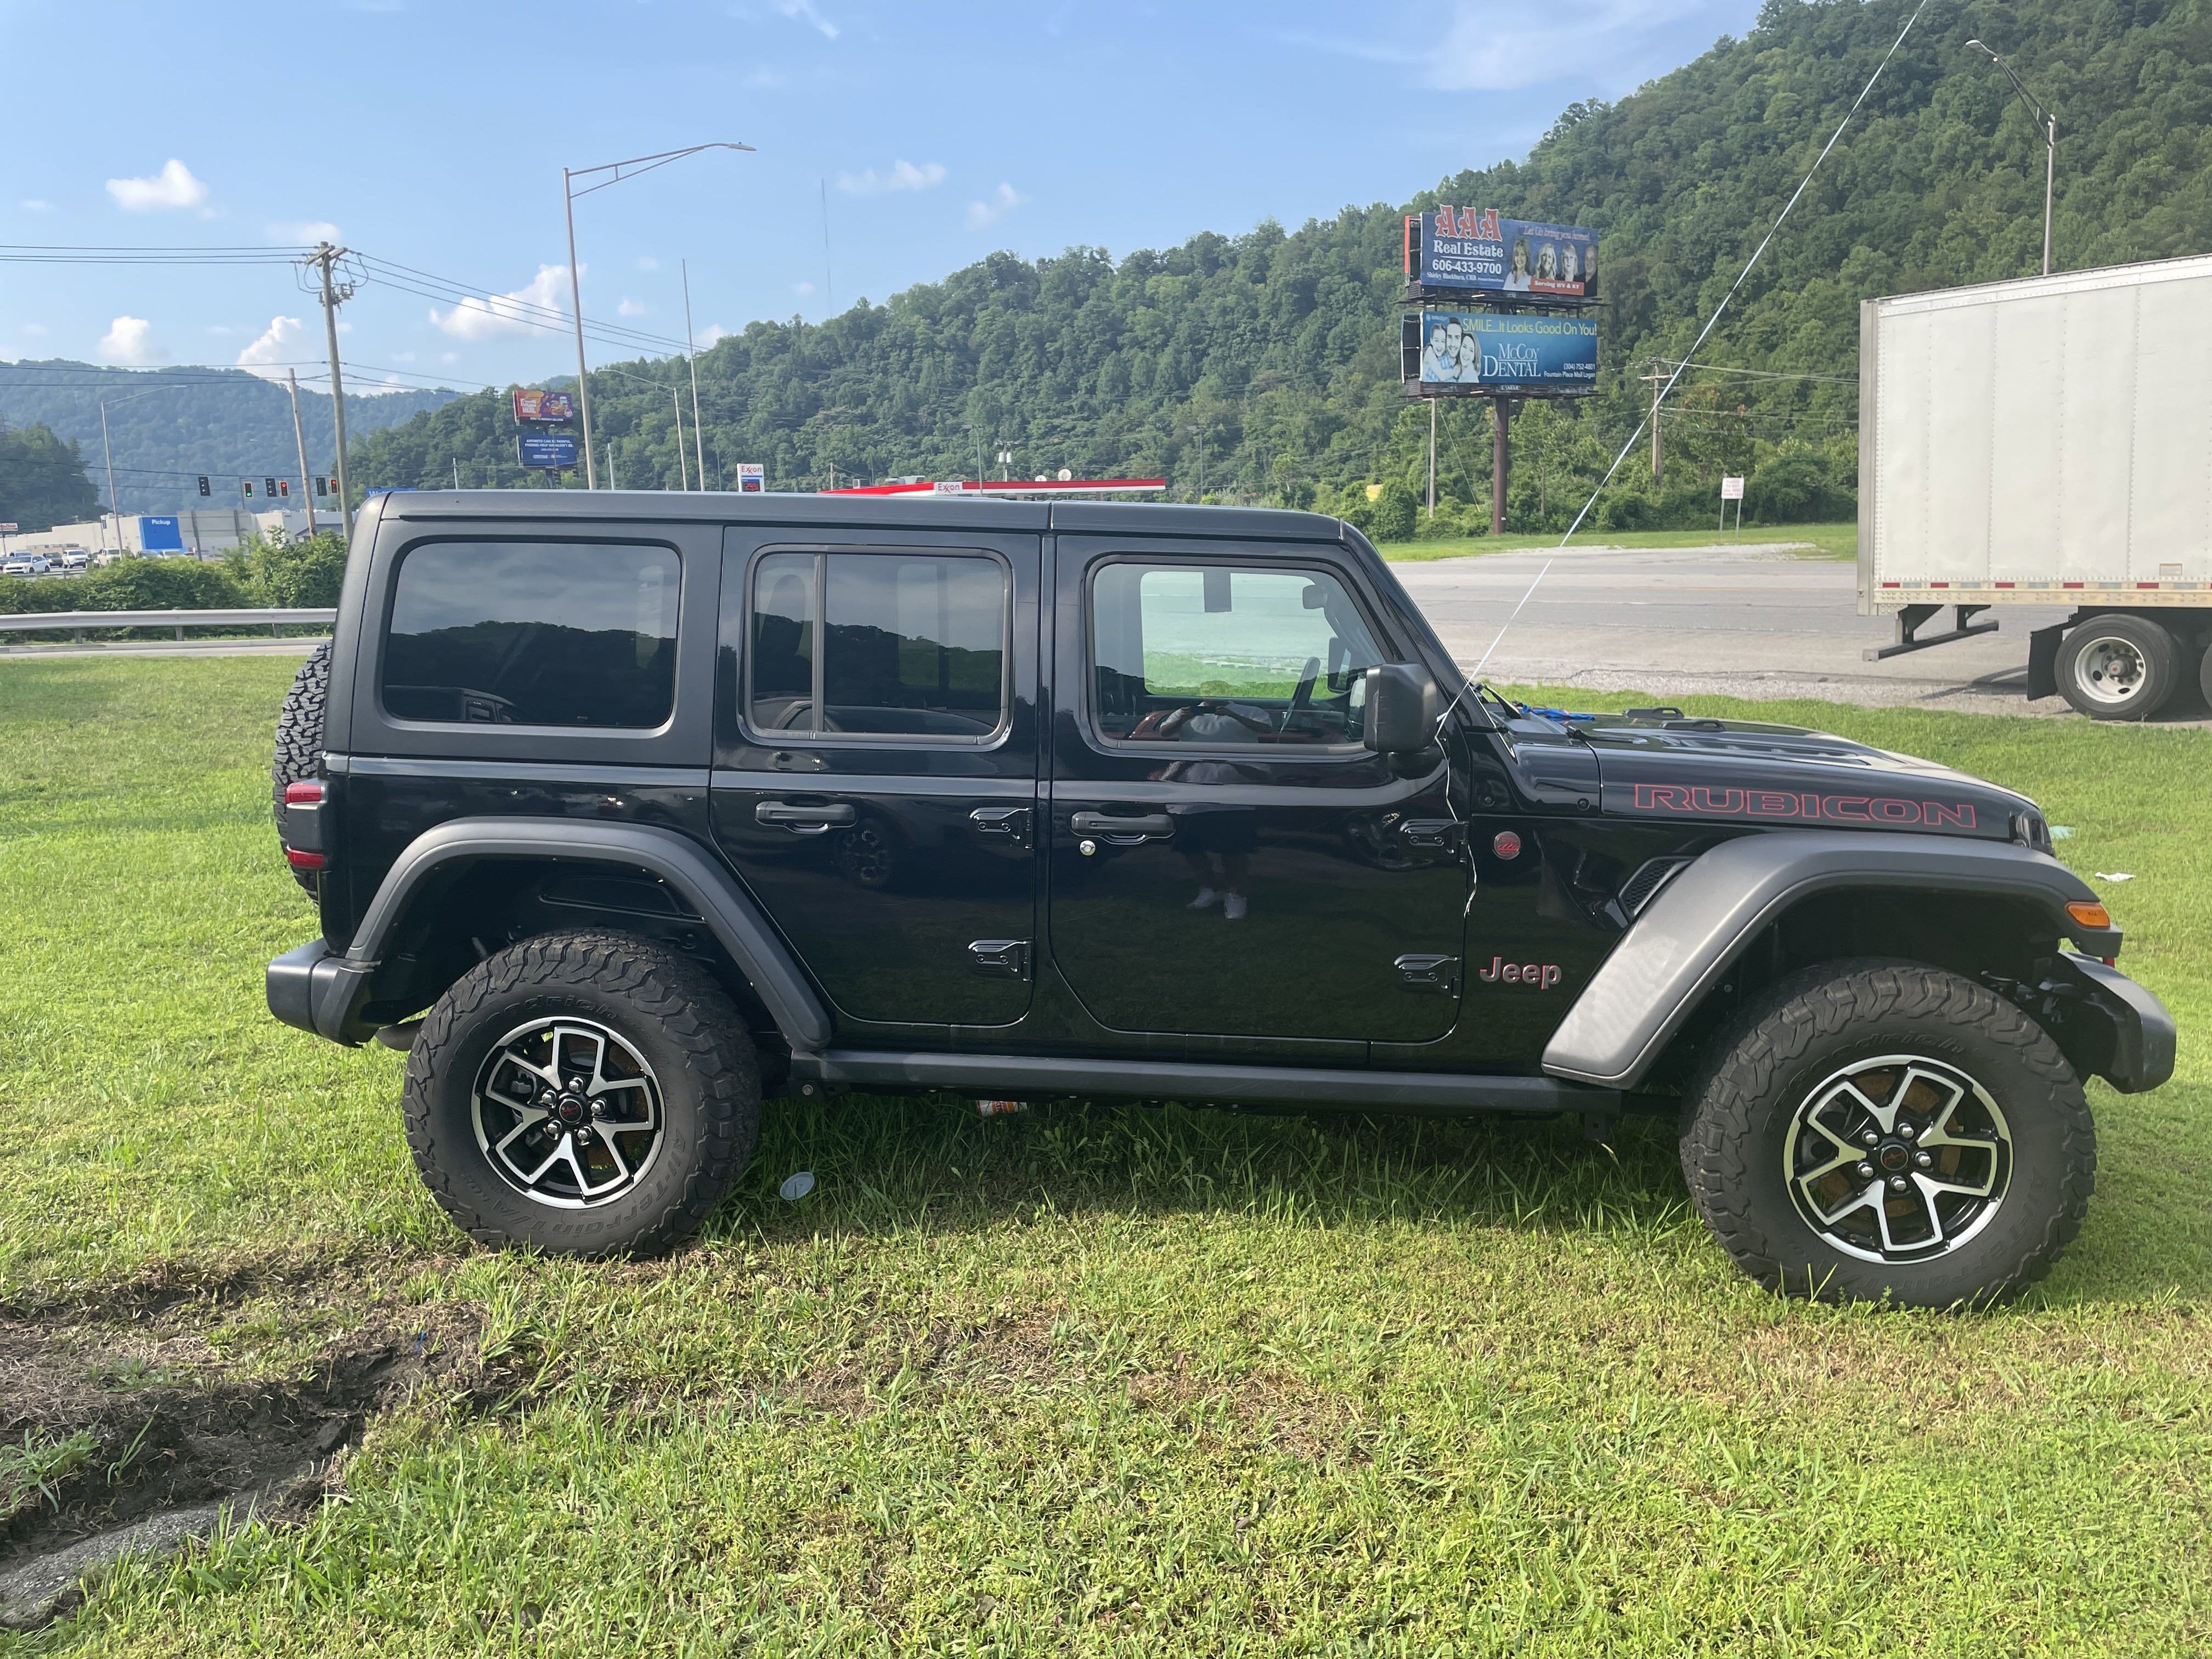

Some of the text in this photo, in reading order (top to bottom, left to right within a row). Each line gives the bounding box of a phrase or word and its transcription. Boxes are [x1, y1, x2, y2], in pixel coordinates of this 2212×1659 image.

[1435, 204, 1503, 242] AAA
[1433, 240, 1504, 258] Real Estate
[1432, 259, 1502, 275] 606-433-9700
[1506, 320, 1533, 334] Looks
[1536, 320, 1562, 335] Good
[1563, 322, 1577, 335] On
[1578, 323, 1597, 336] You!
[1482, 355, 1542, 377] DENTAL
[741, 466, 762, 475] Exxon
[938, 483, 960, 493] Exxon
[1634, 783, 1976, 828] RUBICON
[1479, 956, 1562, 990] Jeep
